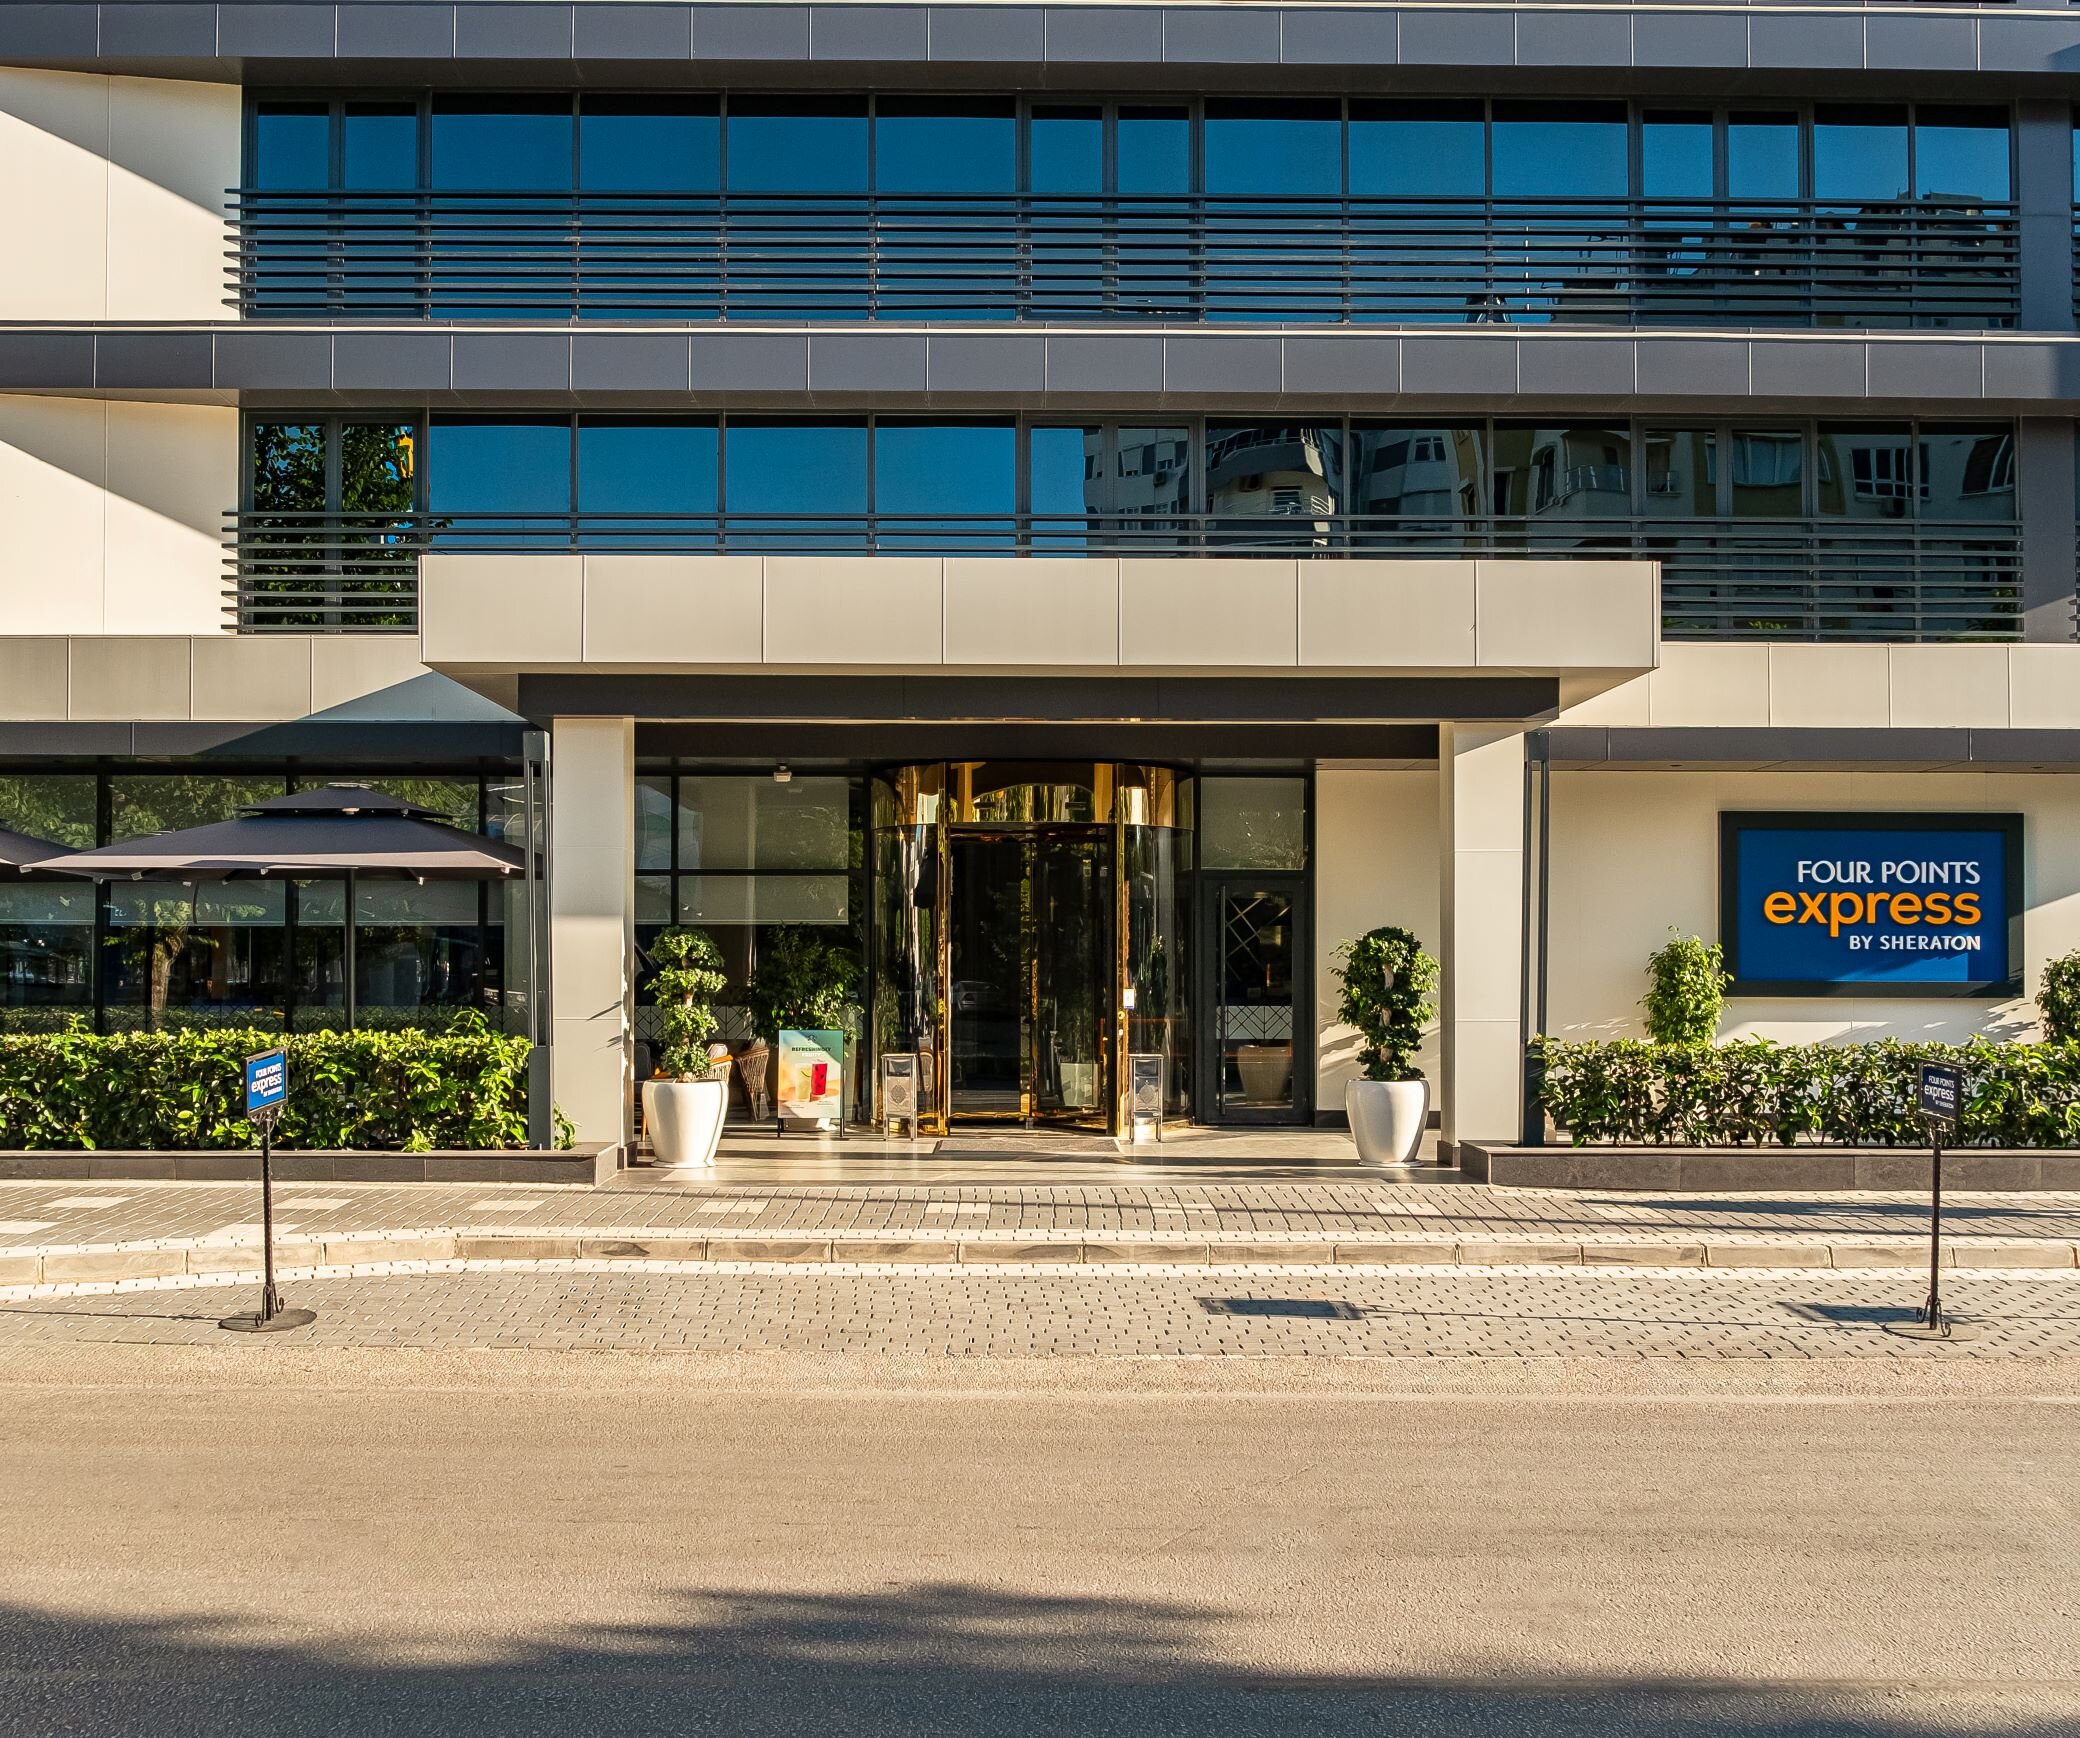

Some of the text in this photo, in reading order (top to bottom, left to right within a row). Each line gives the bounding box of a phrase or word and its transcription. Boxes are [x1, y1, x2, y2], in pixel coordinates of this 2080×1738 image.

[1797, 860, 1981, 885] FOUR POINTS
[1763, 891, 1982, 938] express
[1849, 935, 1981, 951] BY SHERATON
[251, 1072, 282, 1095] express
[1928, 1075, 1955, 1089] FOUR POINTS
[1924, 1084, 1955, 1101] express
